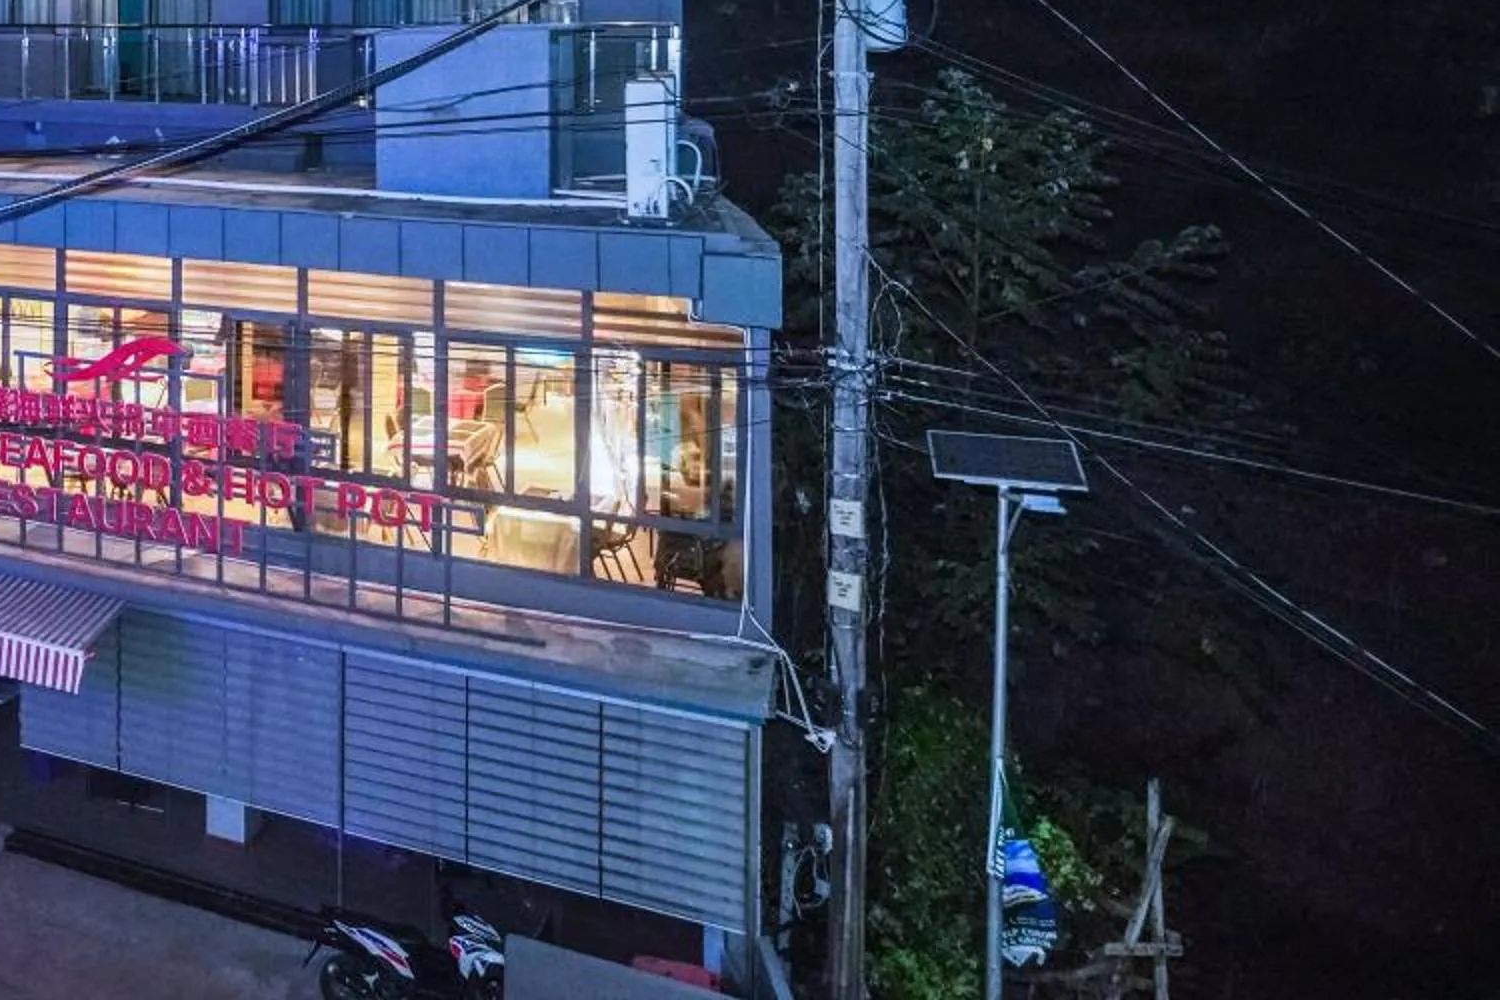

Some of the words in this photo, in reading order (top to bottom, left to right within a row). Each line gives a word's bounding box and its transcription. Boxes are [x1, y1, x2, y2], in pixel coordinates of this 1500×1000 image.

[181, 459, 213, 497] &
[223, 467, 325, 517] HOT
[337, 483, 446, 533] POT
